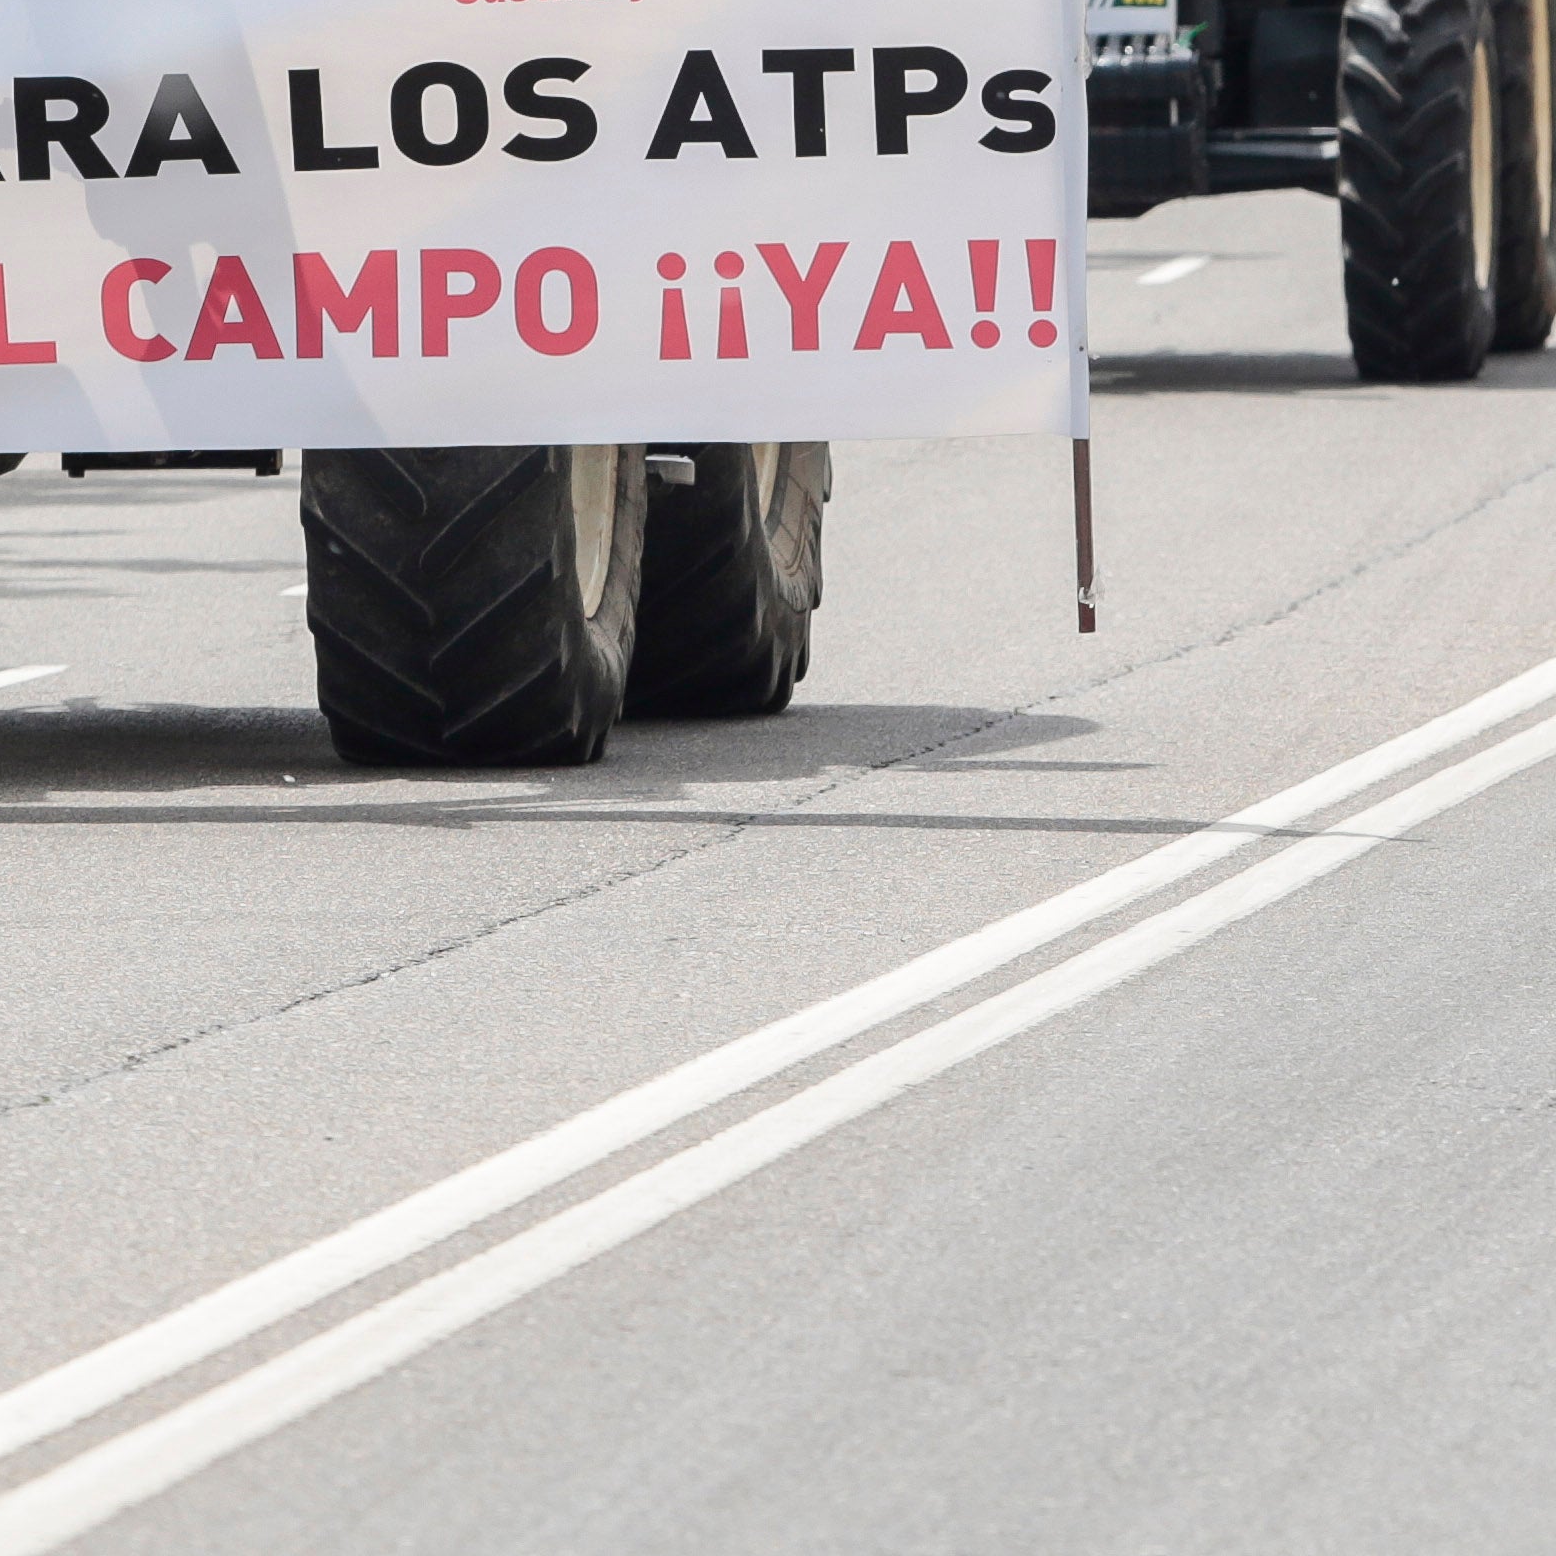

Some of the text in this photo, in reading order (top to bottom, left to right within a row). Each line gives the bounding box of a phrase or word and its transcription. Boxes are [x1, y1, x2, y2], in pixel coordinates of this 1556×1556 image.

[288, 57, 598, 172] LOS
[645, 46, 1056, 160] ATPs
[101, 246, 599, 363] CAMPO
[657, 239, 1058, 362] ¡¡YA!!
